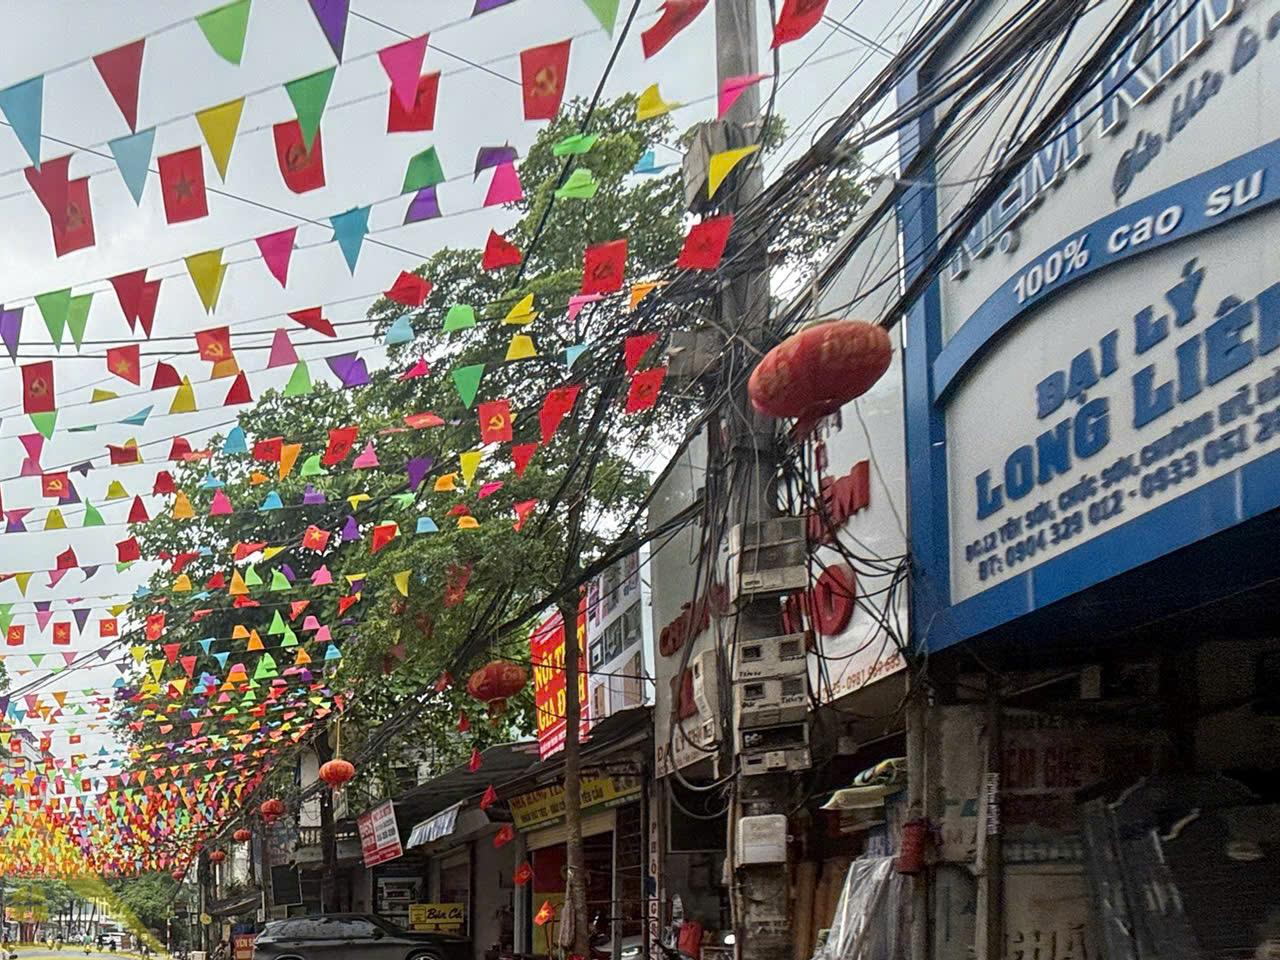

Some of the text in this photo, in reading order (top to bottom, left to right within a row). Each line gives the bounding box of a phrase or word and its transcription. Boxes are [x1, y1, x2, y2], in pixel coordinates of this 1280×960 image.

[1014, 169, 1264, 303] 100% cao su
[1134, 257, 1206, 355] LÝ
[975, 397, 1110, 520] LONG
